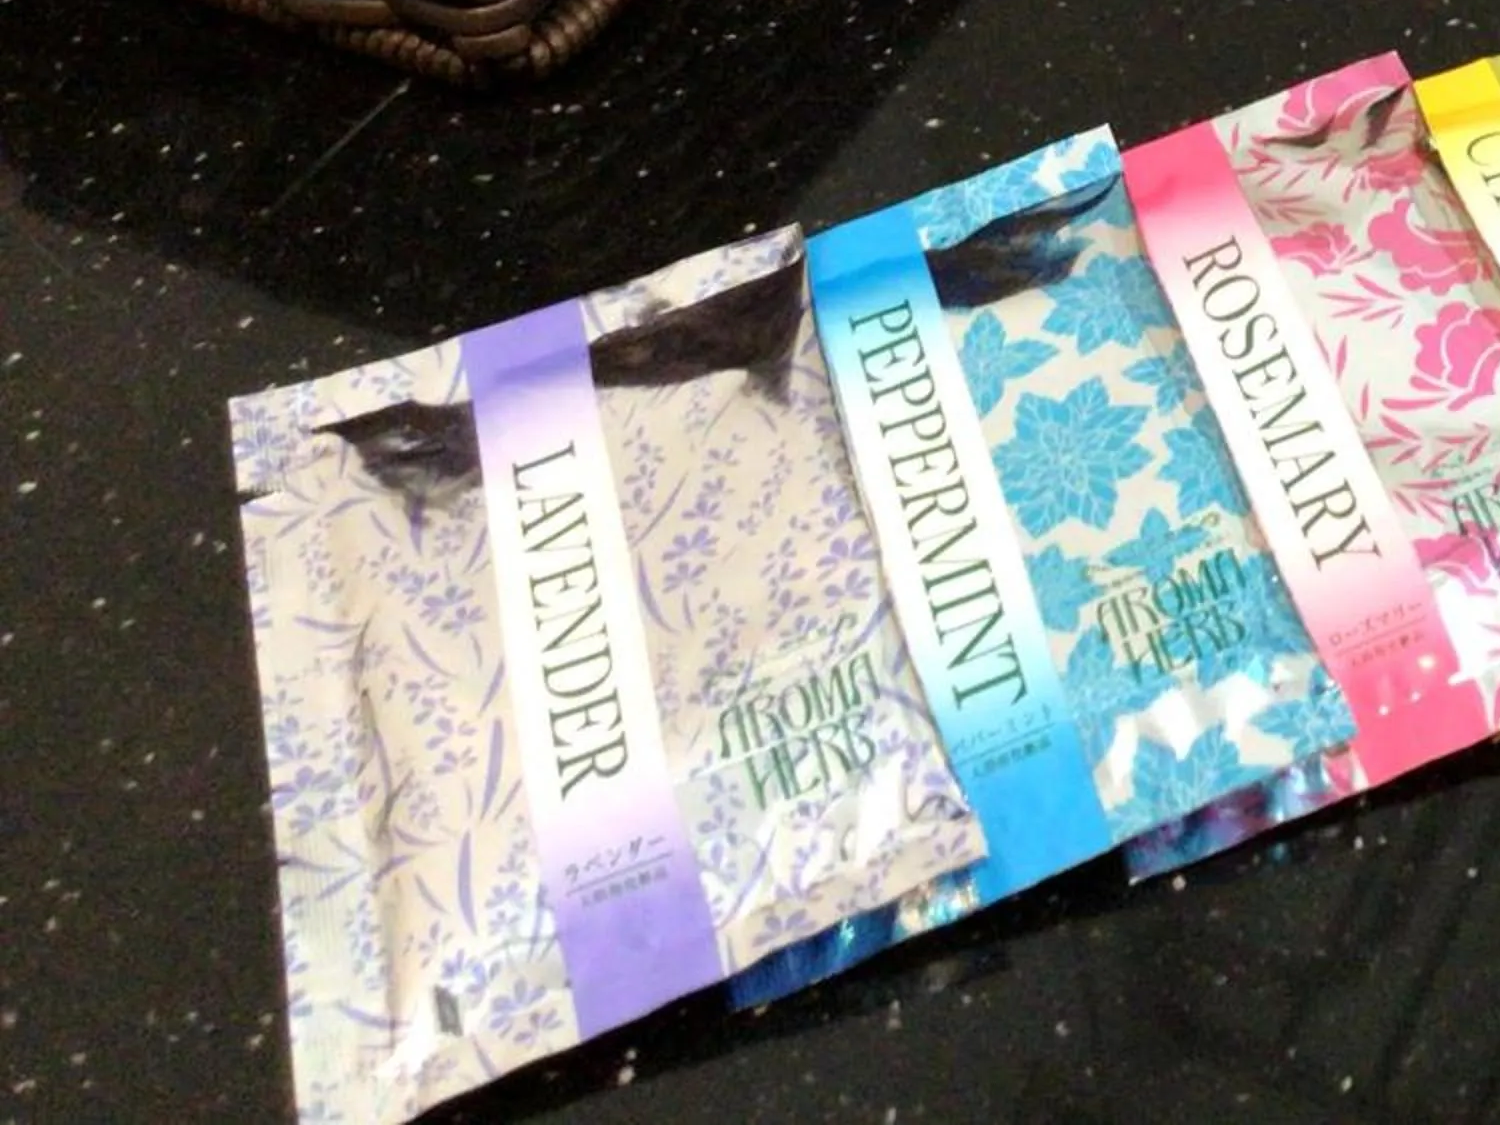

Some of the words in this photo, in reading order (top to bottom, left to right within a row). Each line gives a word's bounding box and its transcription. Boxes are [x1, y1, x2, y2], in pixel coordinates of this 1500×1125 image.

[1182, 233, 1382, 571] ROSEMARY
[848, 298, 1030, 712] PEPPERMINT
[510, 438, 631, 800] LAVENDER
[1096, 547, 1247, 644] AROMA
[1121, 597, 1247, 686] HERB
[718, 651, 882, 760] AROMA
[744, 709, 877, 811] HERB
